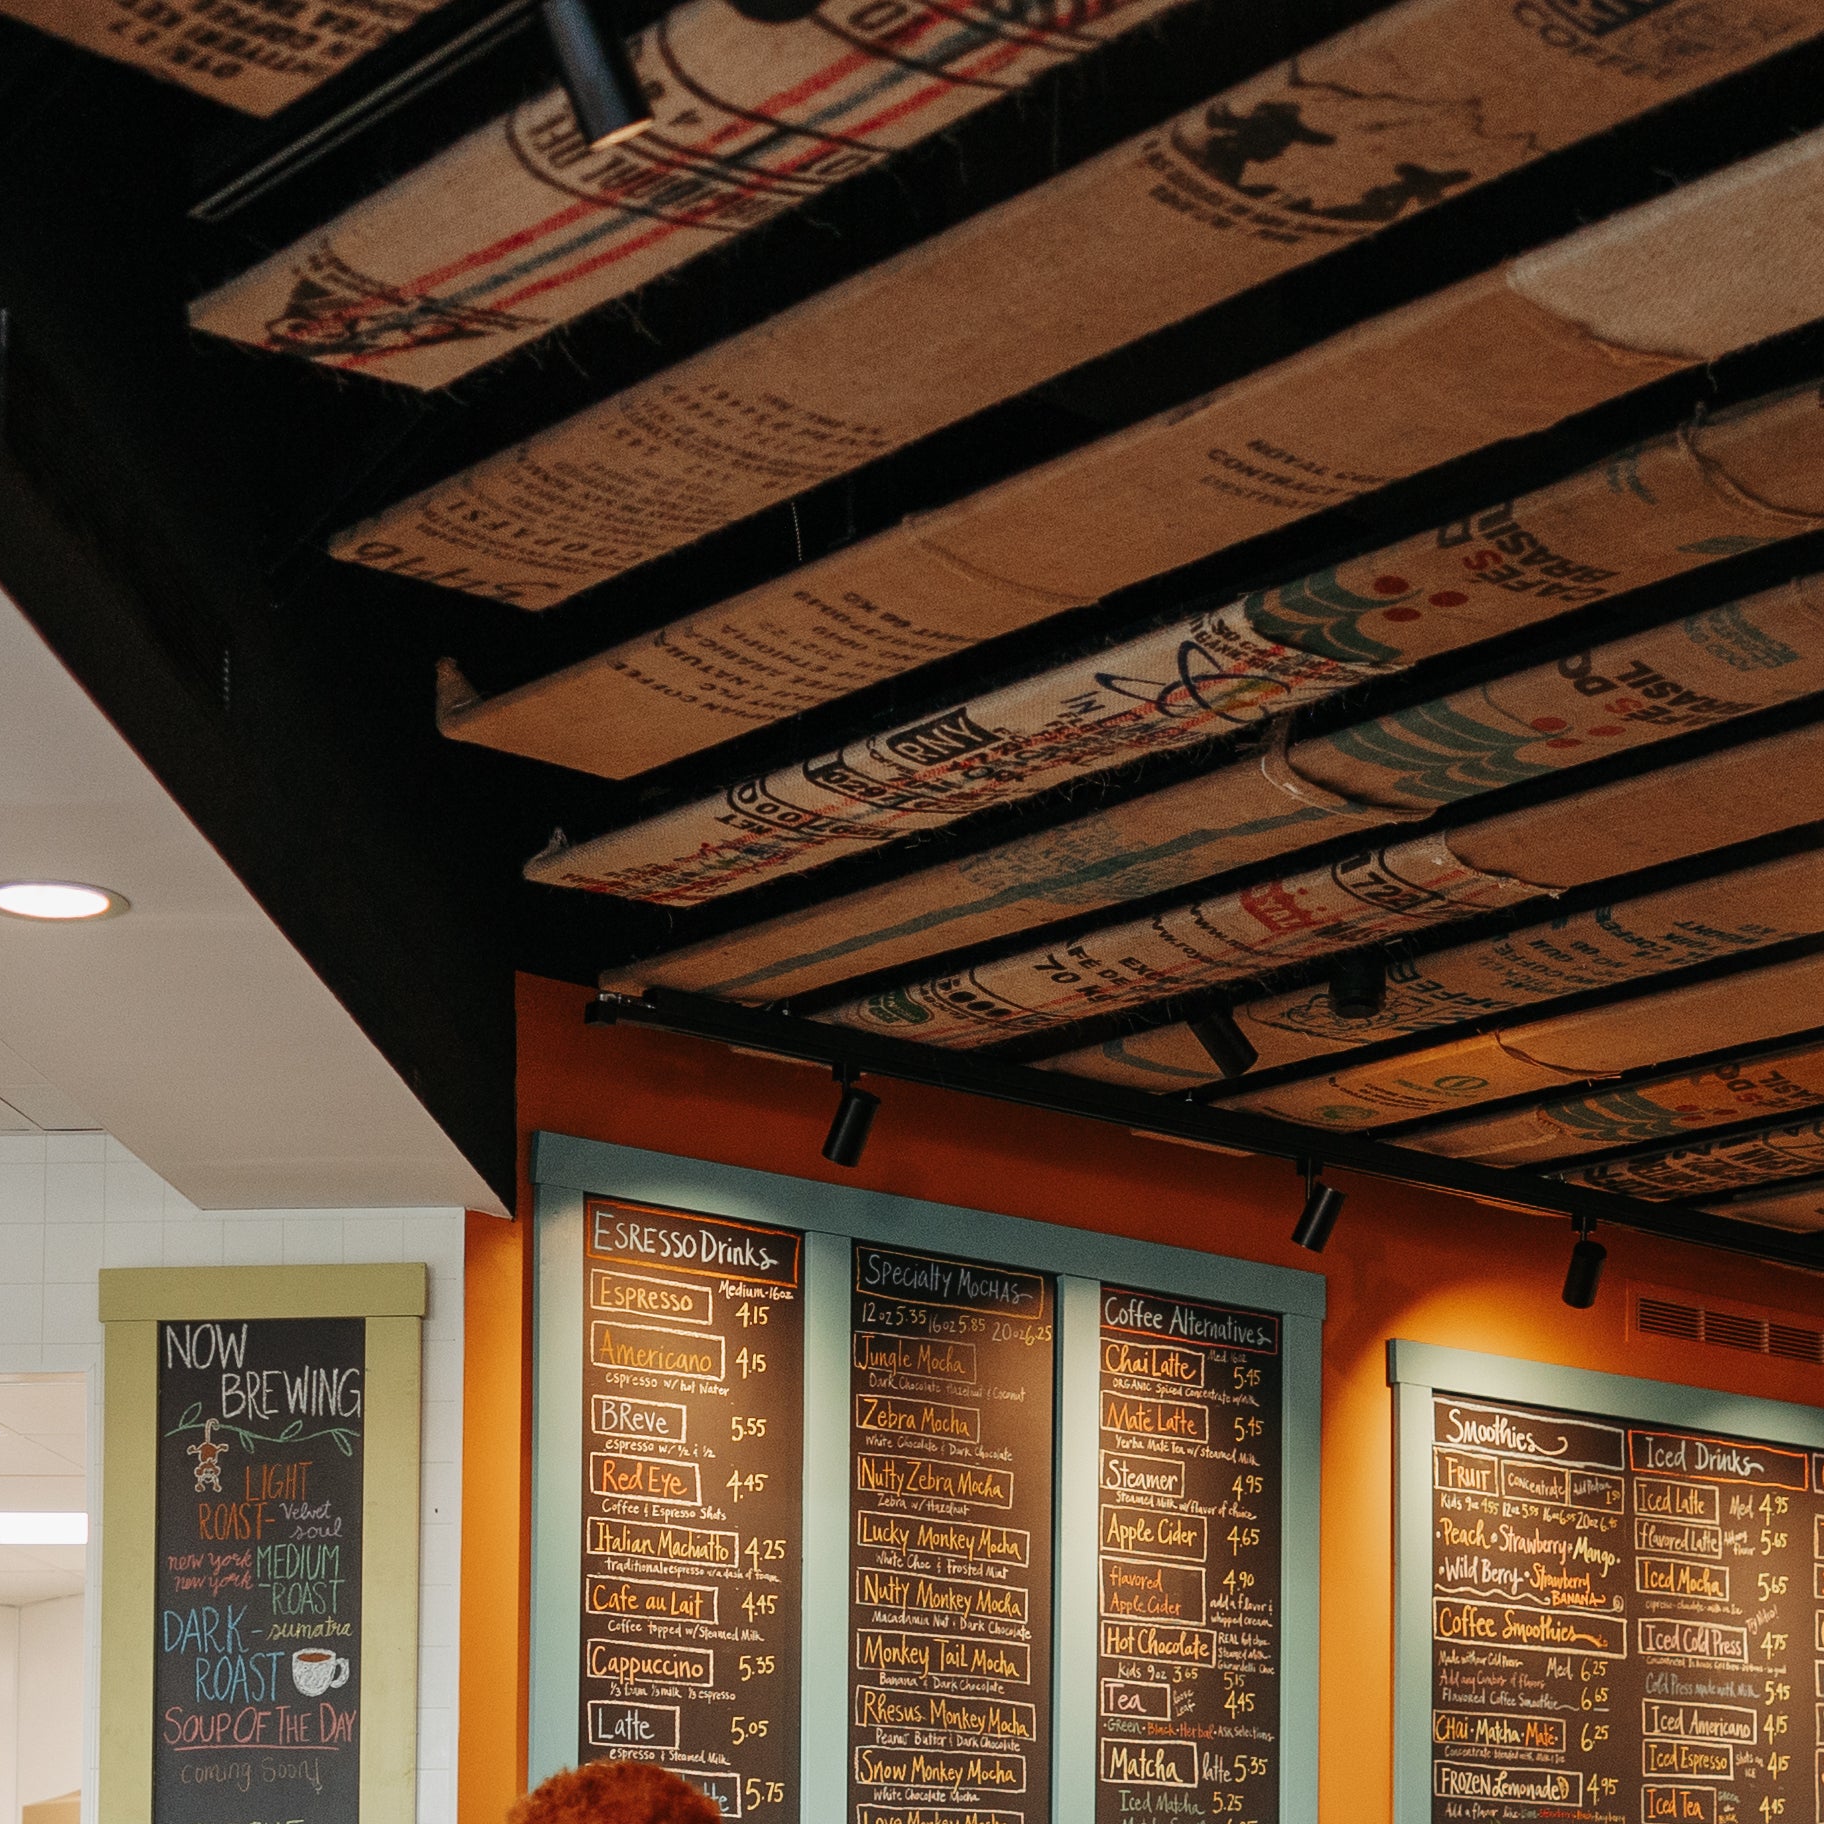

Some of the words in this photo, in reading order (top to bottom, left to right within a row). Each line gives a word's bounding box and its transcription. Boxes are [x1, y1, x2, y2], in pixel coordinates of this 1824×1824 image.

[699, 1230, 779, 1270] Drinks
[1105, 1297, 1163, 1329] Coffee
[1169, 1305, 1272, 1346] Alternatives
[166, 1323, 248, 1369] NOW
[600, 1329, 712, 1373] Americano
[736, 1347, 767, 1379] 4.15
[856, 1335, 912, 1376] Jungle
[917, 1345, 966, 1374] Mocha
[1105, 1344, 1148, 1373] Chai
[1152, 1348, 1196, 1380] Latte
[221, 1365, 361, 1420] BREWING
[862, 1398, 916, 1430] Zebra
[921, 1407, 970, 1437] Mocha
[1446, 1408, 1568, 1456] Smoothies
[1645, 1436, 1687, 1472] Iced
[1695, 1442, 1764, 1476] Drinks
[246, 1462, 313, 1501] LIGHT
[603, 1460, 643, 1492] Red
[649, 1467, 687, 1497] Eye
[861, 1458, 903, 1497] Nutty
[906, 1461, 955, 1497] Zebra
[957, 1471, 1004, 1498] Mocha
[1106, 1459, 1178, 1492] Steamer
[1232, 1475, 1264, 1502] 4.95
[863, 1517, 909, 1555] Lucky
[917, 1525, 975, 1561] Monkey
[978, 1527, 1021, 1560] Mocha
[1107, 1513, 1155, 1550] Apple
[1158, 1518, 1198, 1547] Cider
[1227, 1525, 1261, 1557] 4.65
[257, 1543, 340, 1580] MEDIUM
[593, 1585, 638, 1611] Cafe
[646, 1593, 666, 1611] au
[671, 1590, 703, 1618] Lait
[864, 1573, 910, 1614] Nutty
[916, 1579, 971, 1619] Monkey
[976, 1588, 1021, 1617] Mocha
[864, 1634, 929, 1679] Monkey
[971, 1649, 1019, 1677] Mocha
[1107, 1627, 1136, 1655] Hot
[1137, 1629, 1209, 1660] Chocolate
[1646, 1624, 1679, 1652] Iced
[1683, 1627, 1709, 1655] Cold
[1712, 1629, 1742, 1657] Press
[196, 1652, 286, 1704] ROAST
[592, 1645, 704, 1684] Cappuccino
[739, 1655, 775, 1681] 5.35
[863, 1690, 926, 1728] Rhesus
[930, 1698, 986, 1735] Monkey
[988, 1707, 1030, 1739] Mocha
[1105, 1683, 1147, 1713] Tea
[598, 1707, 655, 1741] Latte
[731, 1716, 769, 1745] 5.05
[1651, 1706, 1684, 1735] Iced
[1689, 1709, 1751, 1738] Americano
[861, 1750, 907, 1784] Snow
[911, 1755, 963, 1793] Monkey
[967, 1758, 1016, 1784] Mocha
[1110, 1747, 1183, 1783] Matcha
[1233, 1755, 1269, 1783] 5.35
[1649, 1743, 1678, 1771] Iced
[1681, 1746, 1728, 1775] Espresso
[745, 1778, 785, 1811] 5.75
[1647, 1788, 1677, 1819] Iced
[1680, 1791, 1705, 1820] Tea
